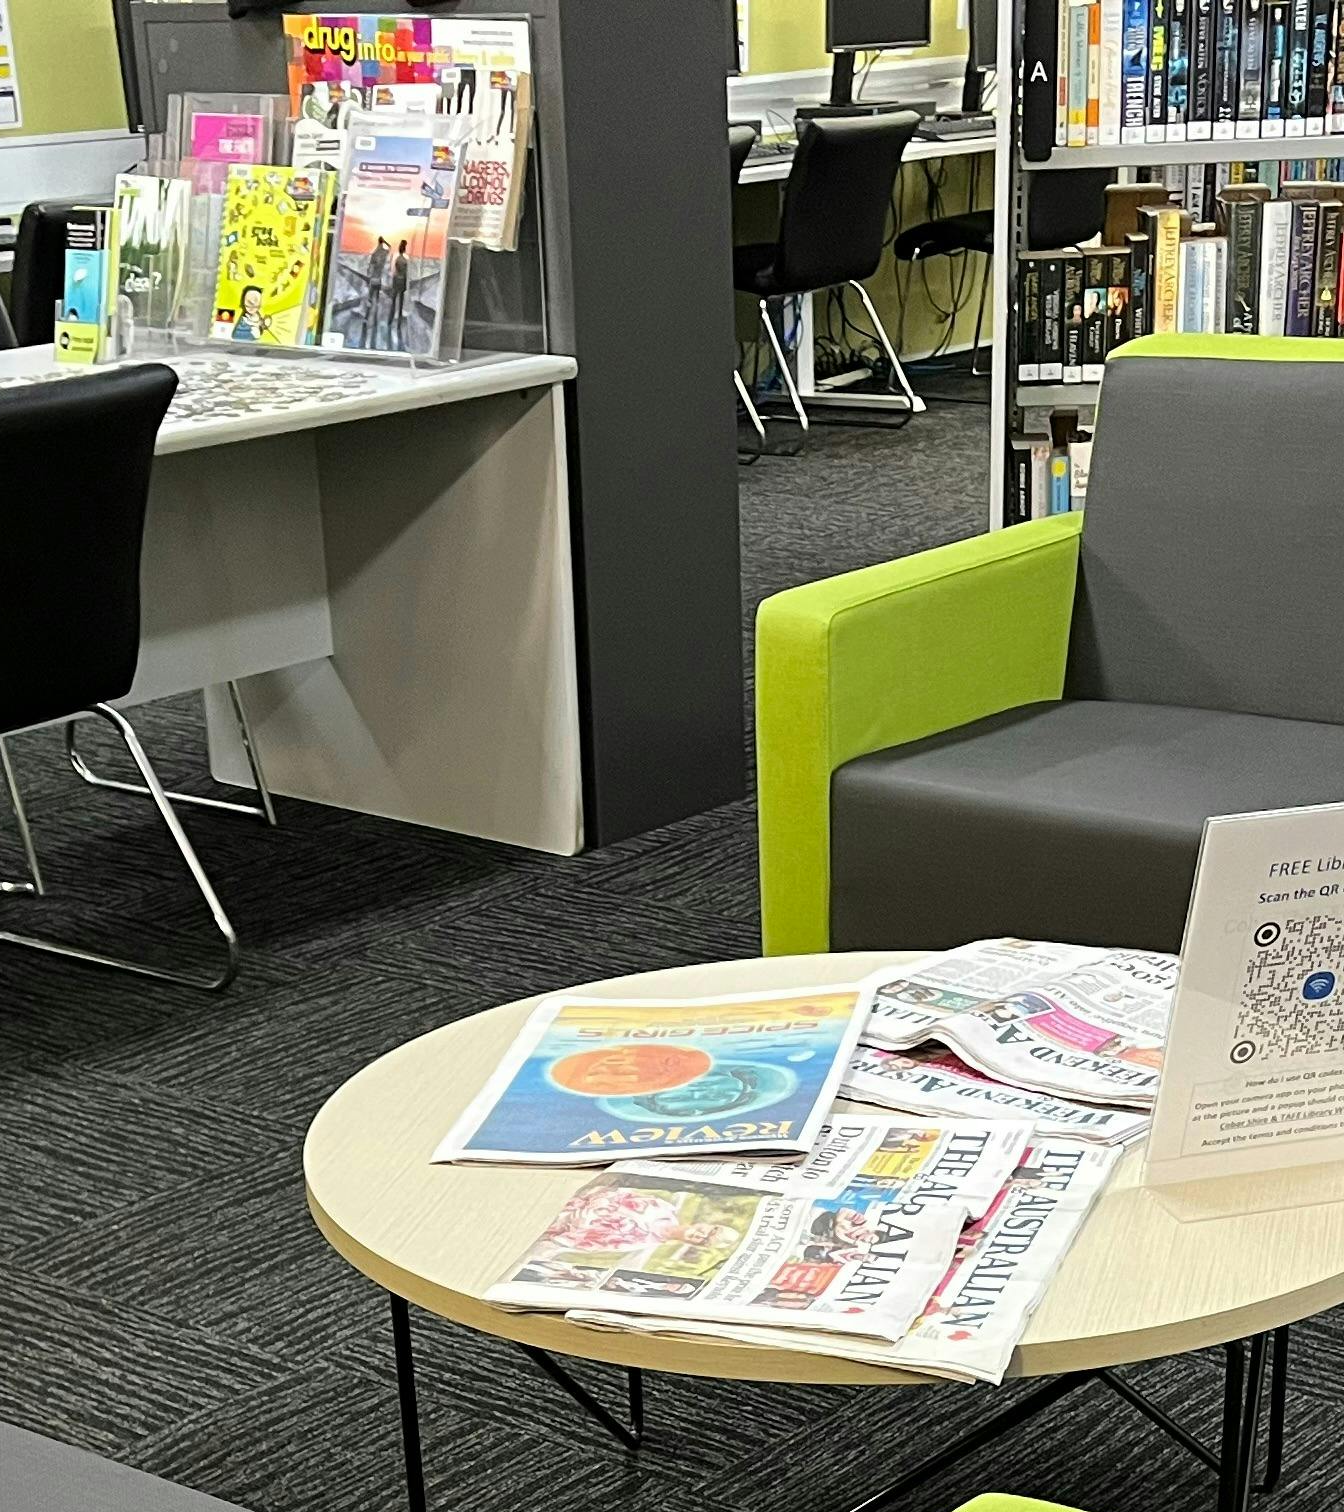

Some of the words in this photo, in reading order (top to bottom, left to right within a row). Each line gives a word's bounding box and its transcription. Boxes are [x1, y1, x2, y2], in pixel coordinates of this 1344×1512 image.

[303, 16, 355, 61] drug
[358, 31, 395, 62] info
[1031, 61, 1048, 82] A
[1125, 76, 1144, 127] TRENCH
[1164, 226, 1177, 272] JEFFREY
[1237, 209, 1255, 250] JEFFREY
[1274, 222, 1289, 271] JEFFREY
[1300, 206, 1316, 259] JEFFREY
[1237, 252, 1253, 289] ARCHER
[1297, 260, 1313, 318] ARCHER
[1162, 273, 1174, 324] ARCHER
[1272, 267, 1285, 322] ARCHER
[1269, 860, 1312, 877] FREE
[1258, 892, 1289, 904] Scan
[1294, 888, 1315, 900] the
[1319, 884, 1339, 896] QR
[577, 1026, 697, 1039] GIRLS
[704, 1020, 820, 1038] SPICE
[1195, 1102, 1218, 1111] Open
[1221, 1098, 1240, 1107] your
[1276, 1090, 1292, 1098] app
[1308, 1085, 1327, 1095] your
[1246, 1080, 1264, 1088] How
[1268, 1077, 1279, 1086] do
[1303, 1071, 1316, 1080] QR
[955, 1087, 1115, 1128] WEEKEND
[1203, 1112, 1217, 1120] the
[1252, 1104, 1269, 1113] and
[1220, 1121, 1246, 1131] Cobar
[1281, 1112, 1302, 1121] TAFE
[1303, 1107, 1333, 1119] Library
[811, 1127, 864, 1167] Dutton
[929, 1131, 991, 1178] THE
[1201, 1137, 1231, 1147] Accept
[1233, 1134, 1247, 1142] the
[1249, 1130, 1274, 1140] terms
[1276, 1127, 1292, 1136] and
[1294, 1122, 1338, 1134] conditions
[802, 1167, 829, 1179] to
[1041, 1150, 1085, 1191] THE
[940, 1193, 1058, 1329] AUSTRALIAN
